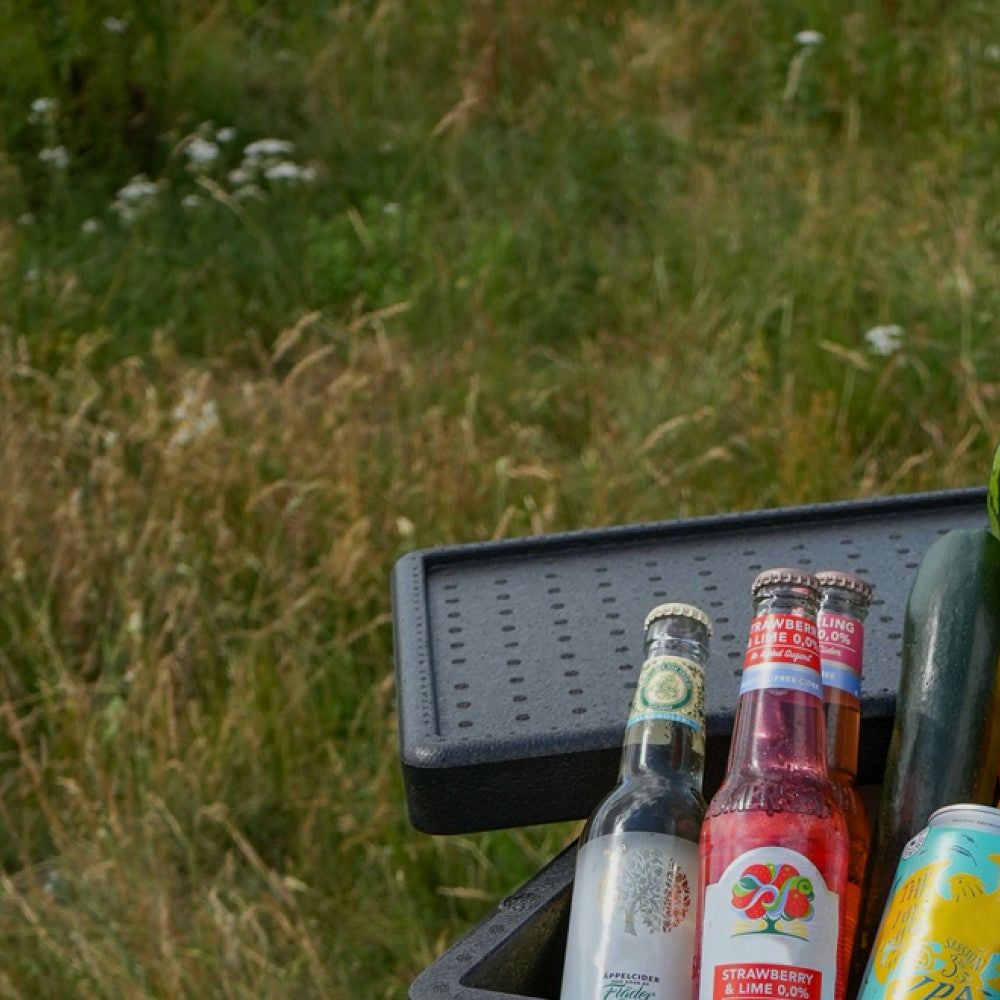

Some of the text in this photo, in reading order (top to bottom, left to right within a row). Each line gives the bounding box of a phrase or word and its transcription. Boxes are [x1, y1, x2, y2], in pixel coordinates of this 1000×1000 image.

[751, 617, 817, 637] TRAWBERR
[755, 632, 787, 645] LIME
[722, 967, 813, 985] STRAWBERRY
[725, 982, 810, 999] & LIME 0,0%
